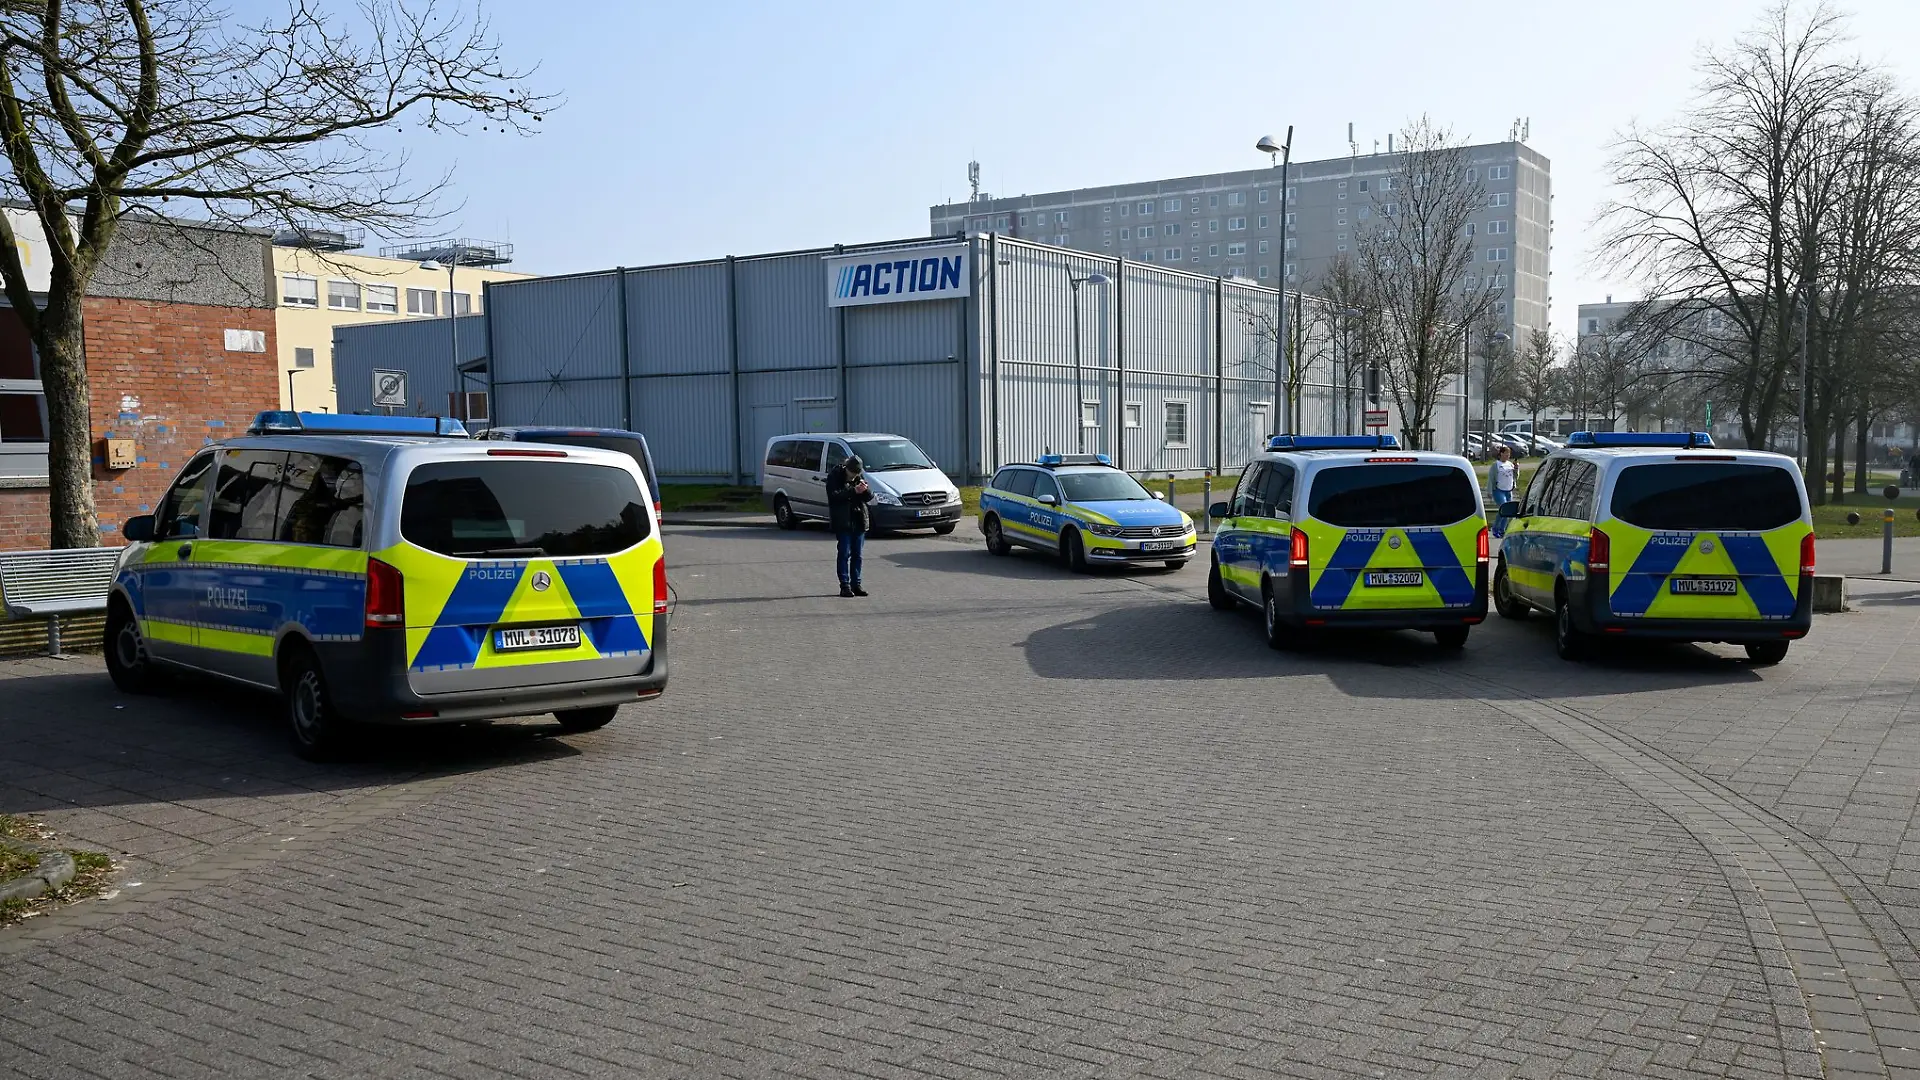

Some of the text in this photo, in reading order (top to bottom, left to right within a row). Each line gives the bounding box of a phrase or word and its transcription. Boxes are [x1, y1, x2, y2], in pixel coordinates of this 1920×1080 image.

[850, 255, 962, 298] ACTION
[383, 380, 396, 390] 20
[1030, 511, 1053, 527] POLIZEI
[1345, 534, 1380, 542] POLIZEI
[1651, 537, 1690, 546] POLIZEI
[469, 569, 516, 580] POLIZEI
[1371, 573, 1420, 584] MVL 32007
[1678, 580, 1734, 592] MVL 31192
[207, 586, 249, 611] POLIZEI
[504, 627, 577, 647] MVL 31078
